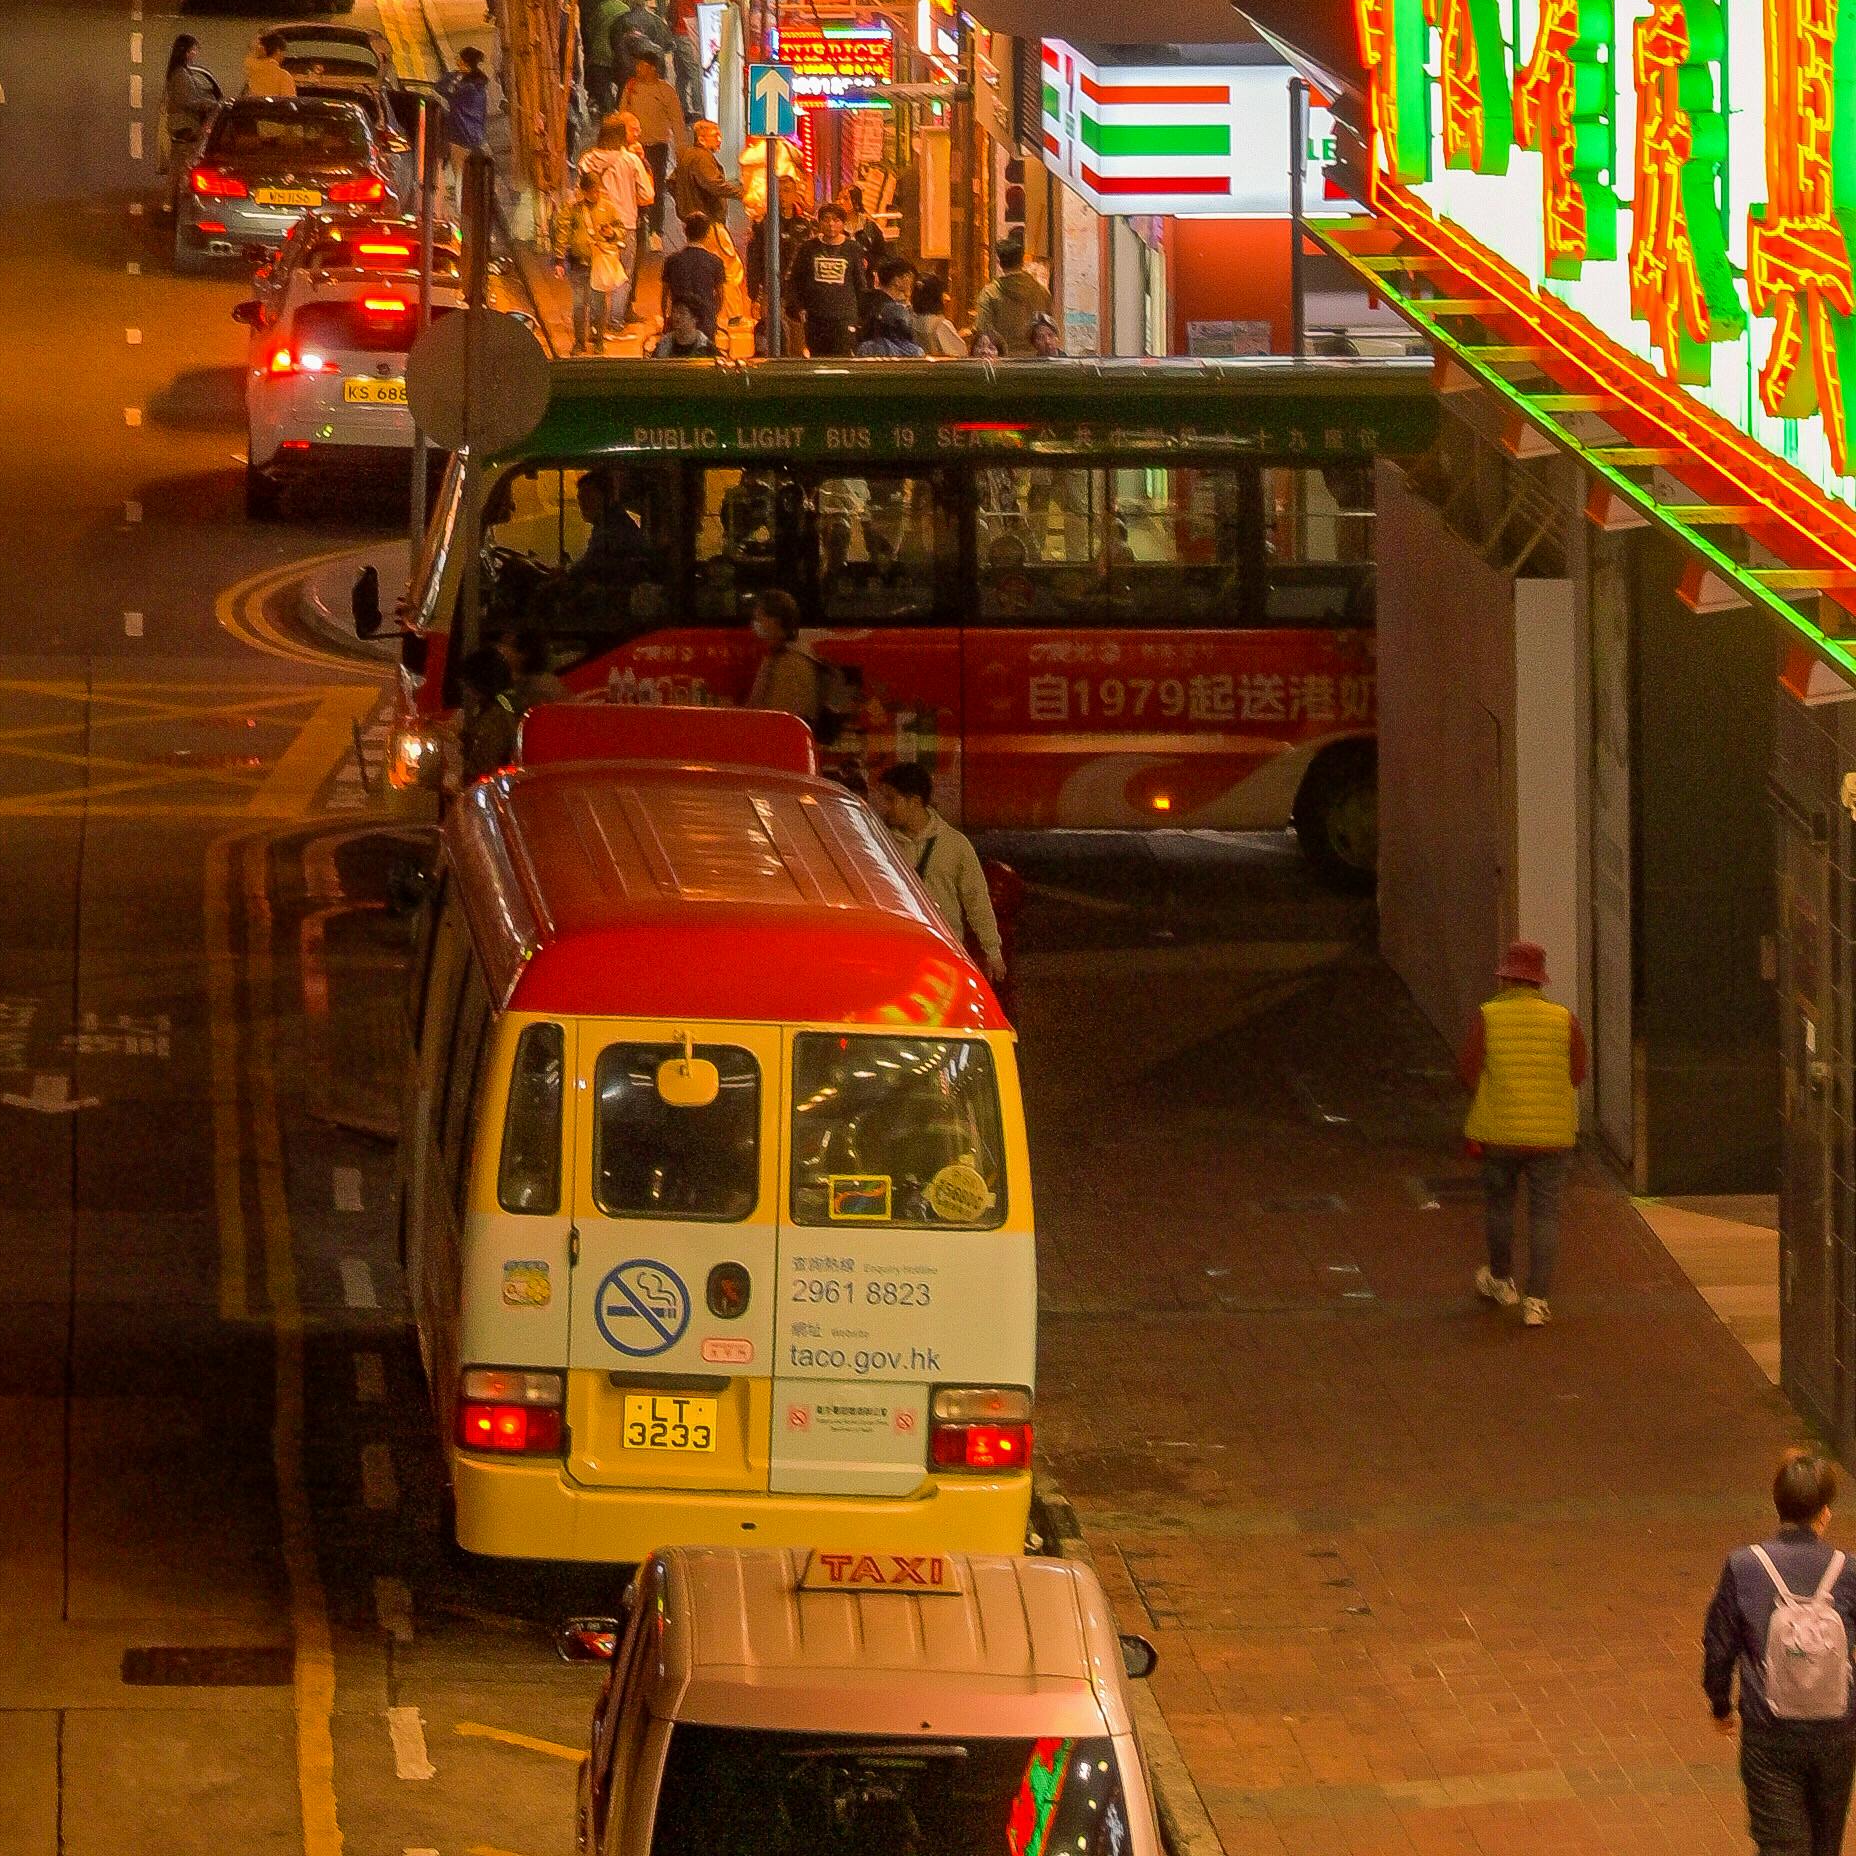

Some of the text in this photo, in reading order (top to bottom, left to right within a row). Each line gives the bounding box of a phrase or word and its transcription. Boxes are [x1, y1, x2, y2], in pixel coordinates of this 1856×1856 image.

[348, 386, 369, 399] KS
[633, 426, 718, 450] PUBLIC
[736, 426, 805, 450] LIGHT
[826, 426, 871, 450] BUS
[893, 426, 915, 450] 19
[792, 1279, 931, 1306] 2961 8823
[790, 1343, 941, 1374] taco.gov.hk
[651, 1397, 690, 1423] LT
[628, 1422, 711, 1448] 3233
[819, 1555, 944, 1587] TAXI
